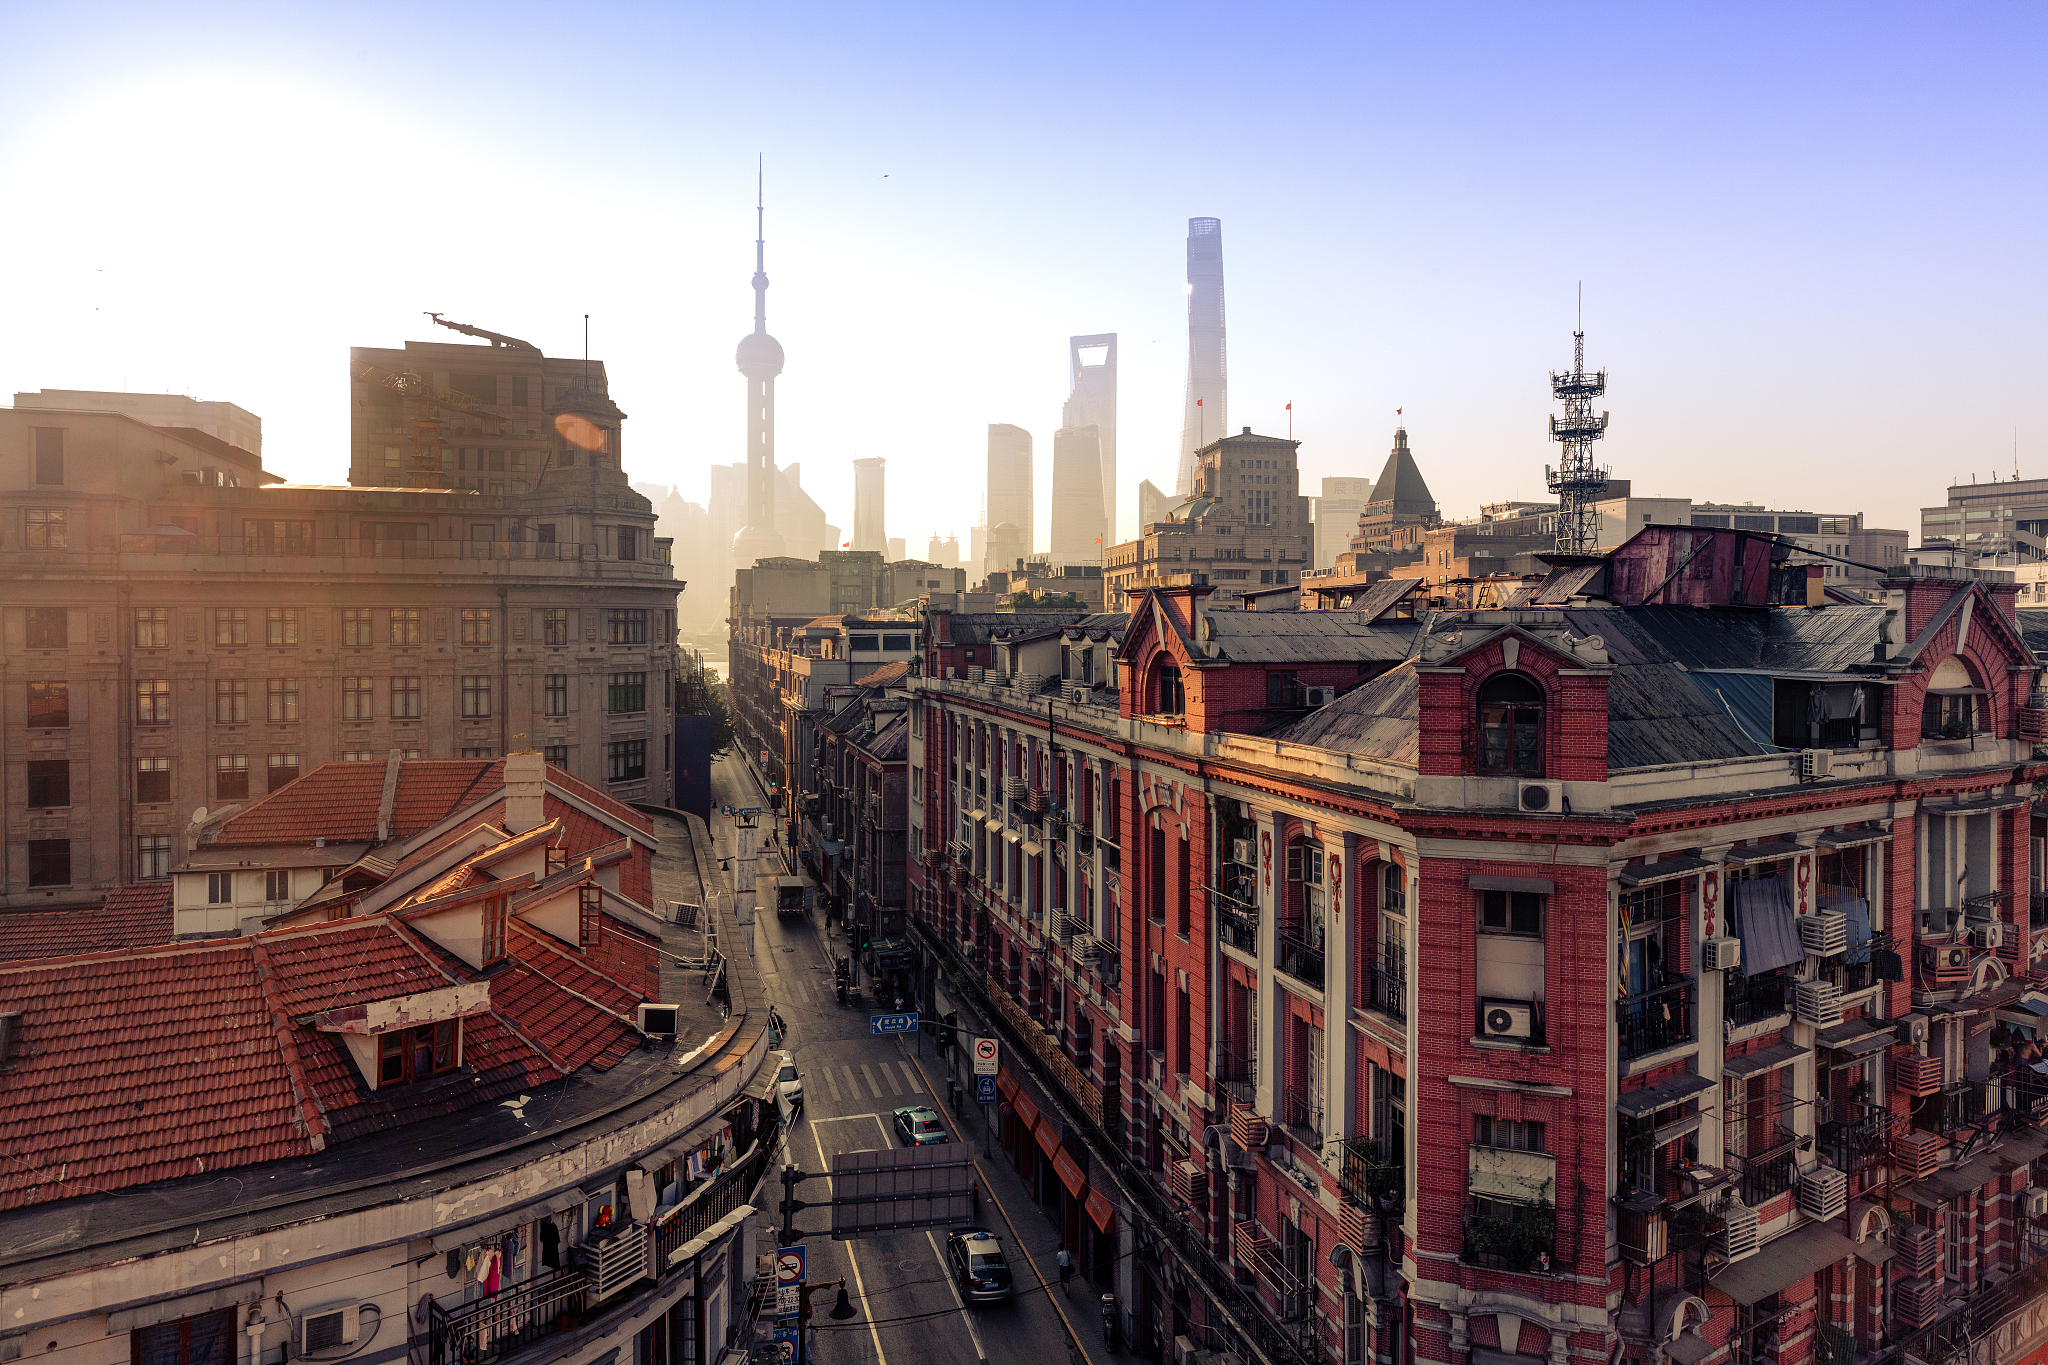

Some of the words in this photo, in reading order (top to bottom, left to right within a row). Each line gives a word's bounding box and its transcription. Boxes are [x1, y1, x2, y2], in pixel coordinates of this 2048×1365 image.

[1334, 480, 1362, 494] 震旦
[778, 1286, 800, 1295] 山东一路
